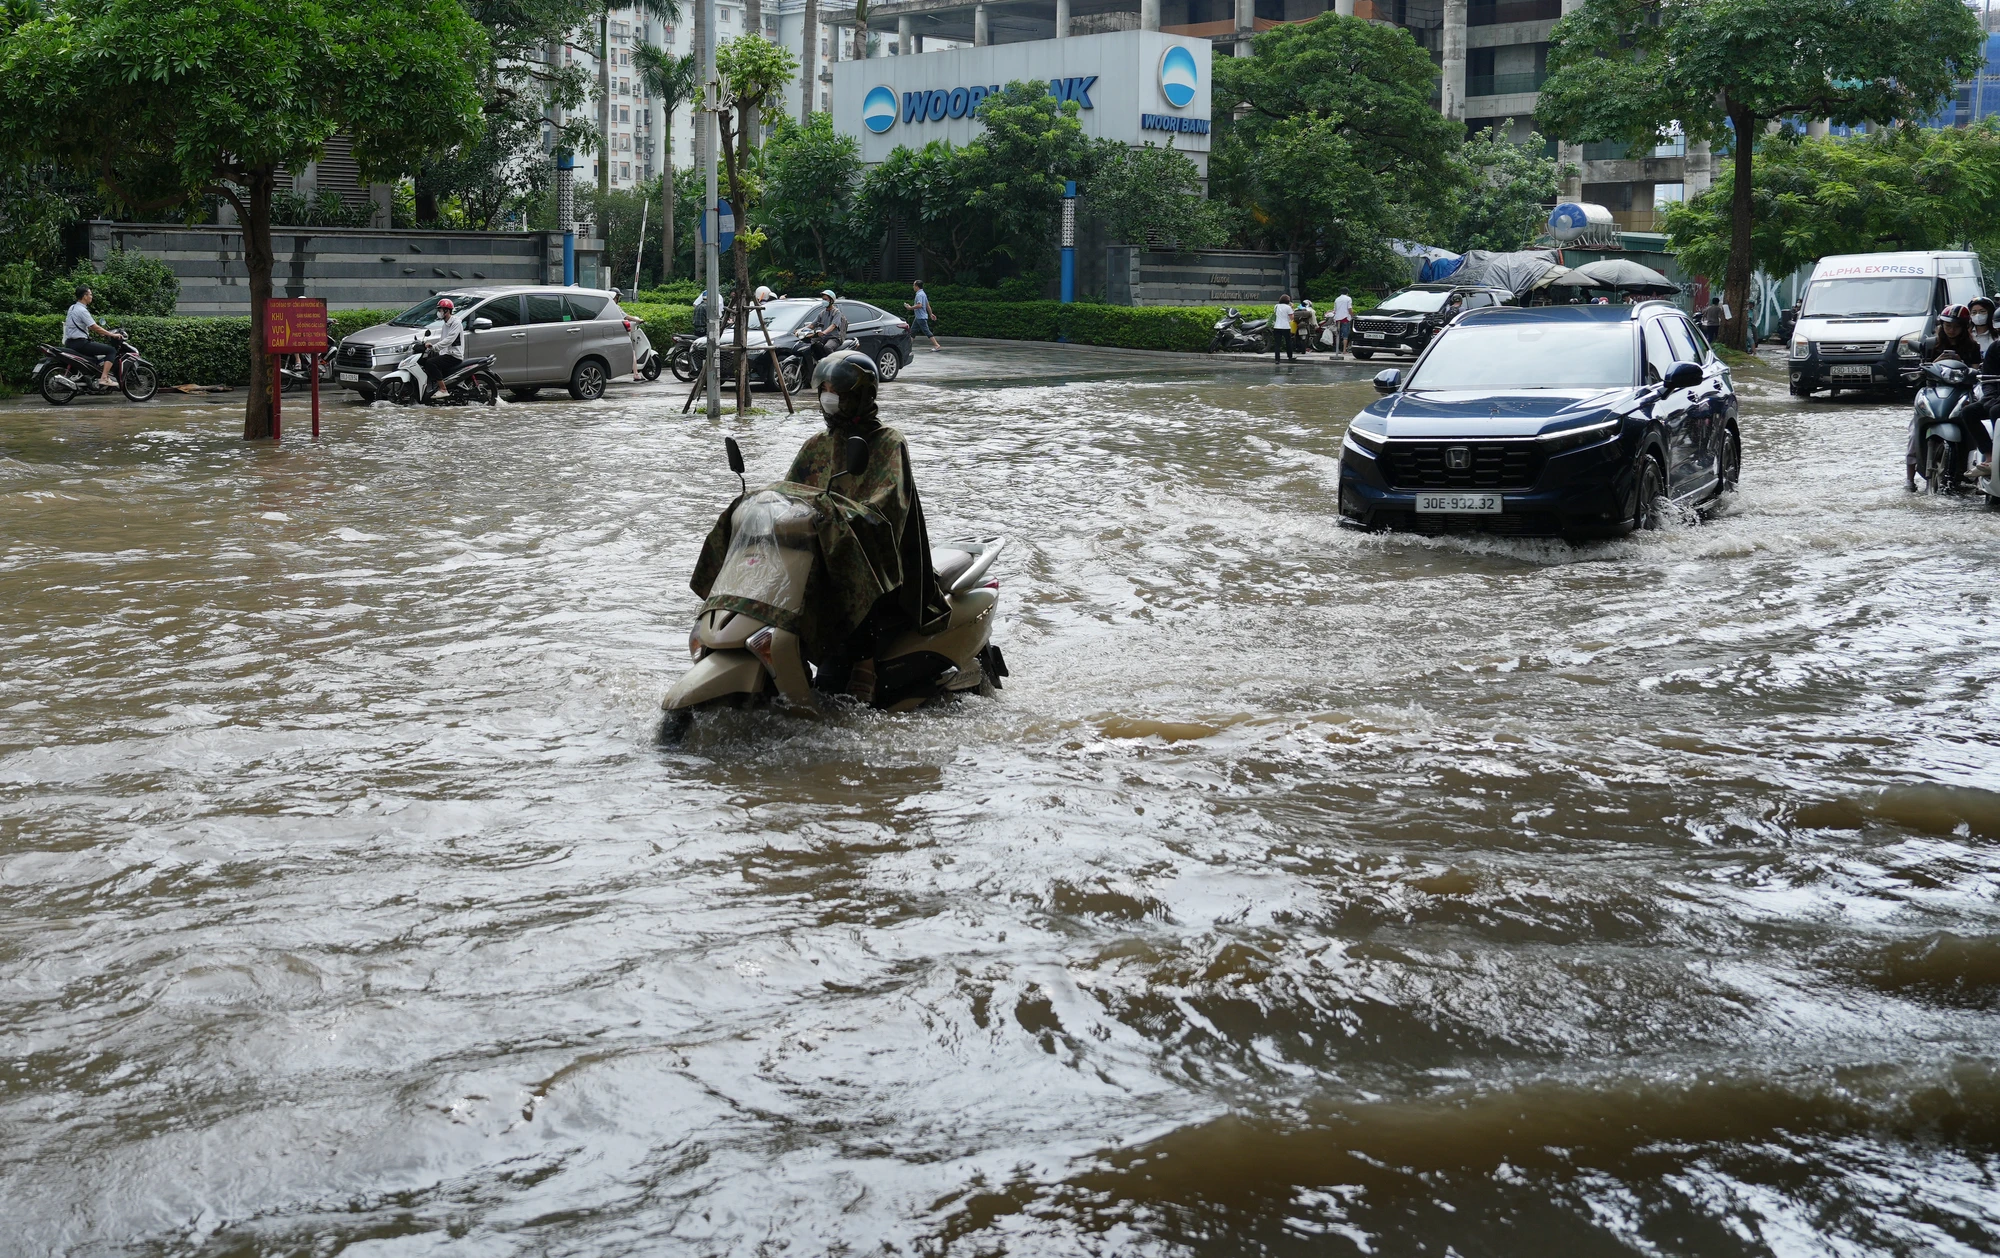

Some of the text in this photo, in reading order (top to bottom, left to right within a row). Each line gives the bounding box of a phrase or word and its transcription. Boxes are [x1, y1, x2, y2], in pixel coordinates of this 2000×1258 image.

[1144, 114, 1211, 134] WOORI BANK
[1820, 265, 1925, 278] ALPHA EXPRESS
[1210, 289, 1241, 300] Landmark
[272, 312, 284, 320] KHU
[272, 326, 284, 335] VỰC
[1423, 498, 1494, 510] 30E-932.32
